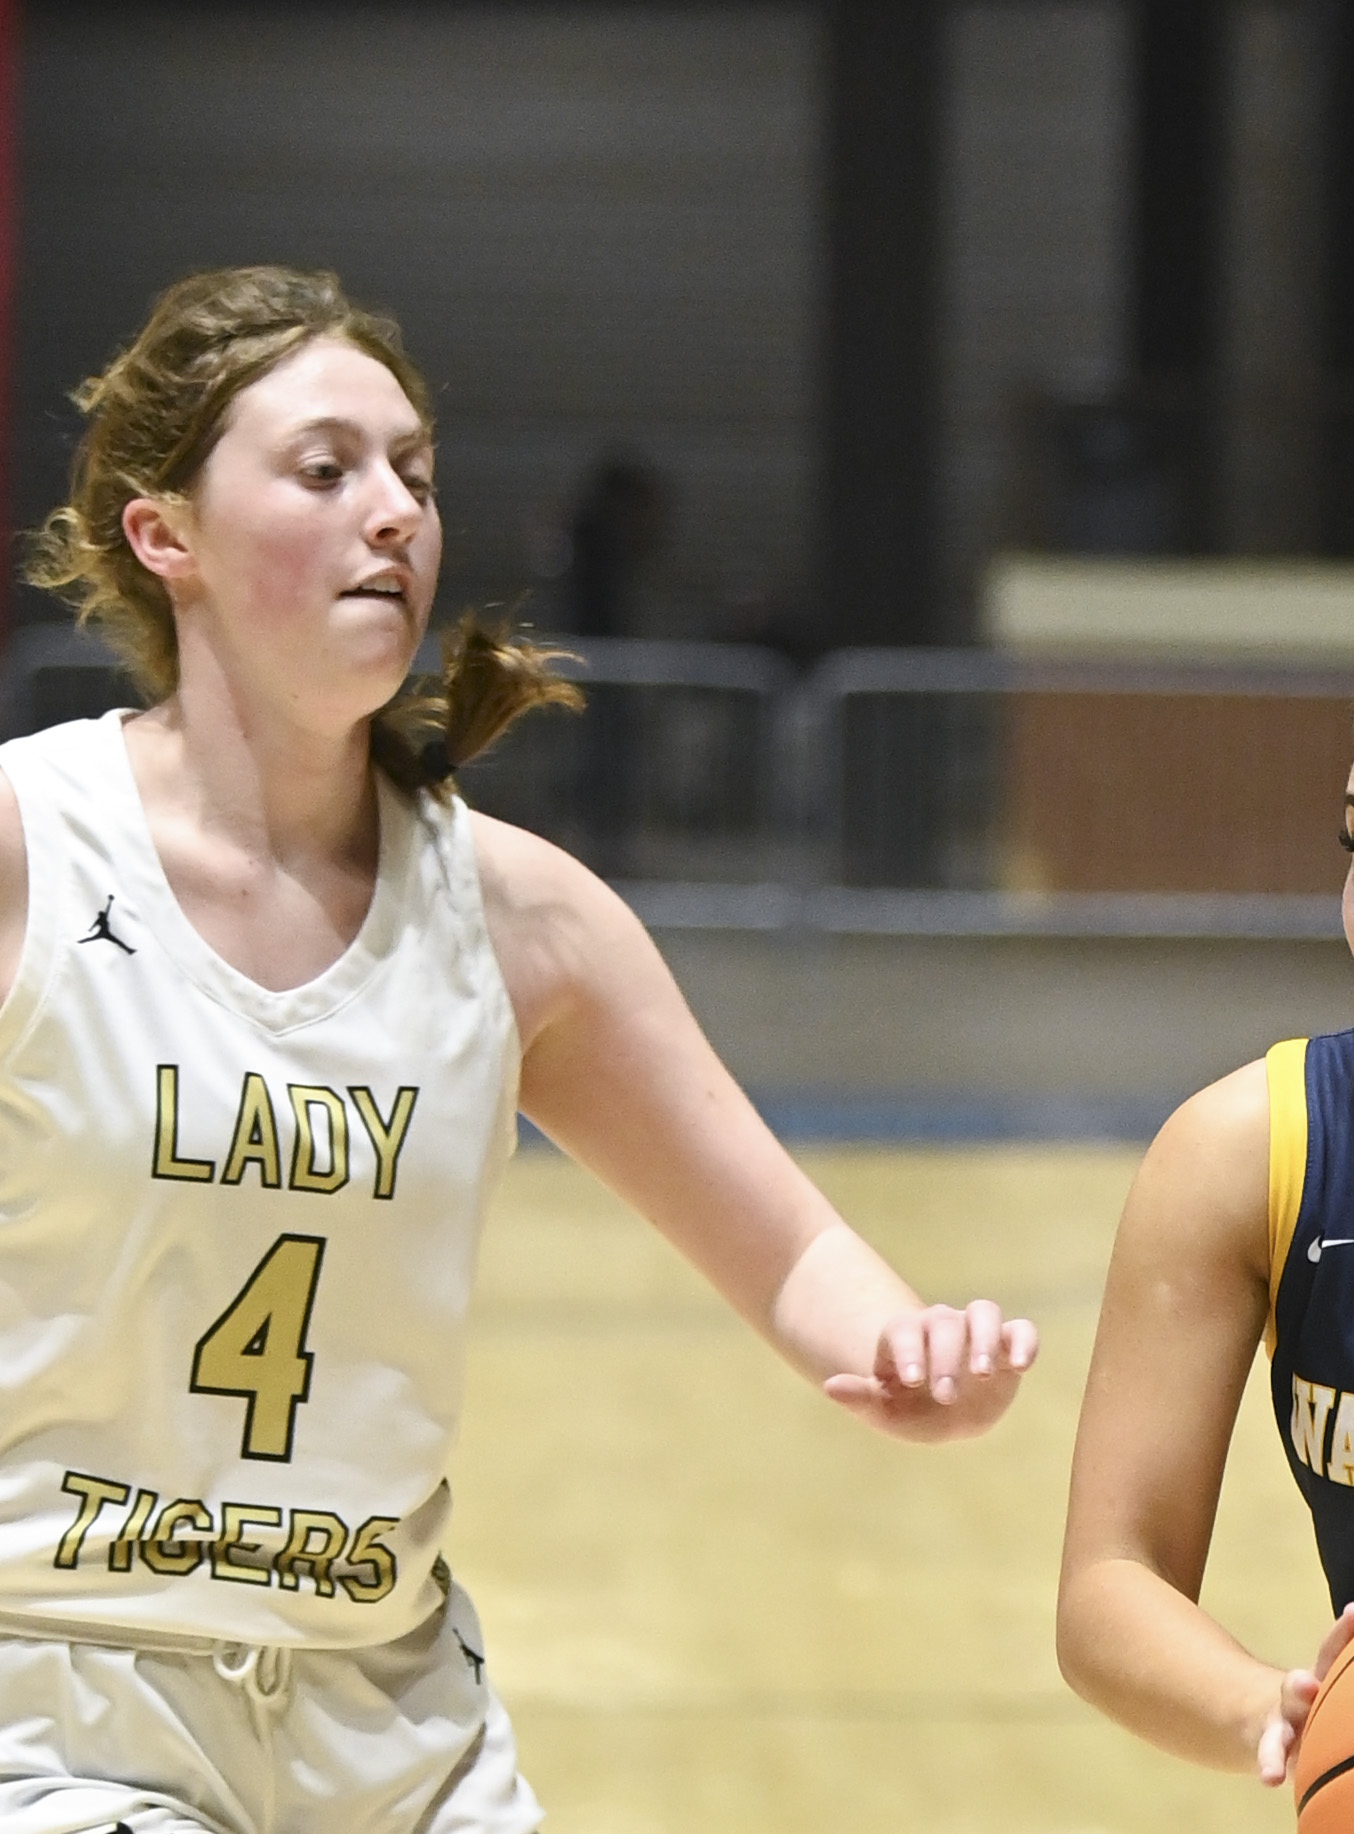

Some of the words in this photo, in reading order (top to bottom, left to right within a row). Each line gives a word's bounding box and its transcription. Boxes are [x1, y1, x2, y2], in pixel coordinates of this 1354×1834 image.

[151, 1064, 420, 1199] LADY
[190, 1233, 327, 1462] 4
[53, 1471, 400, 1603] TIGERS
